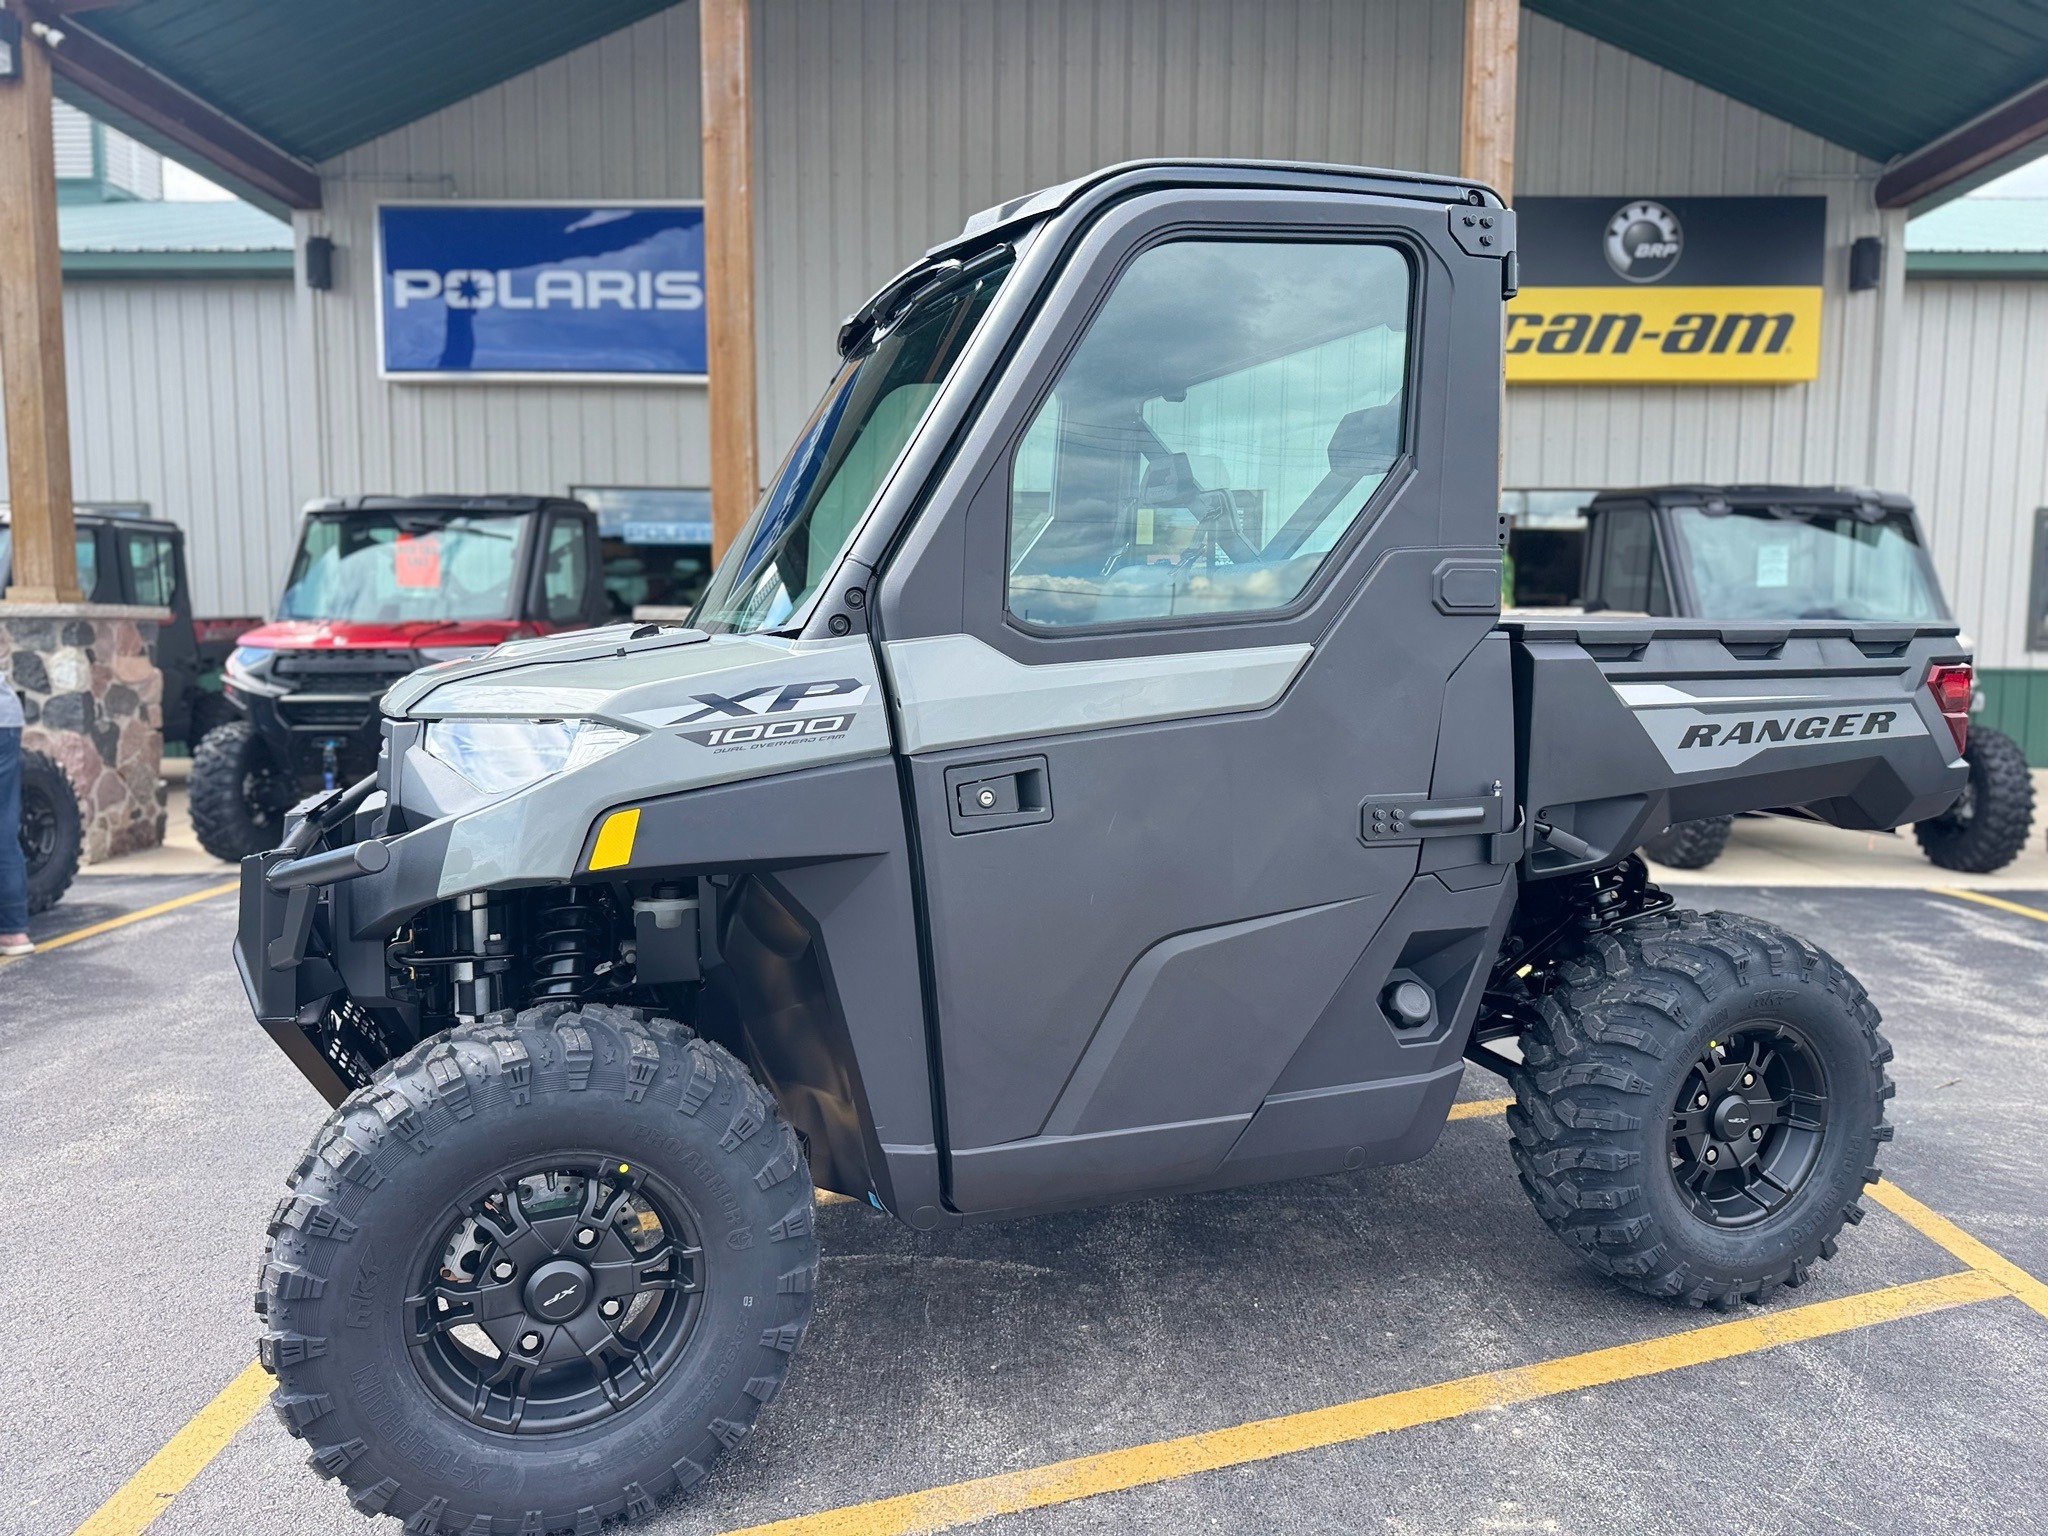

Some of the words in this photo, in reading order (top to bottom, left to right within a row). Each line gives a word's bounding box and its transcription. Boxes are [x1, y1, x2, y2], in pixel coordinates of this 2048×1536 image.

[1635, 242, 1679, 258] BRP
[393, 269, 704, 310] POLARIS
[663, 678, 864, 726] XP
[708, 716, 845, 746] 1000
[713, 745, 747, 754] DUAL
[750, 737, 816, 750] OVERHEAD
[819, 733, 846, 743] CAM
[1678, 711, 1897, 749] RANGER
[352, 1363, 491, 1492] X-TERRAIN
